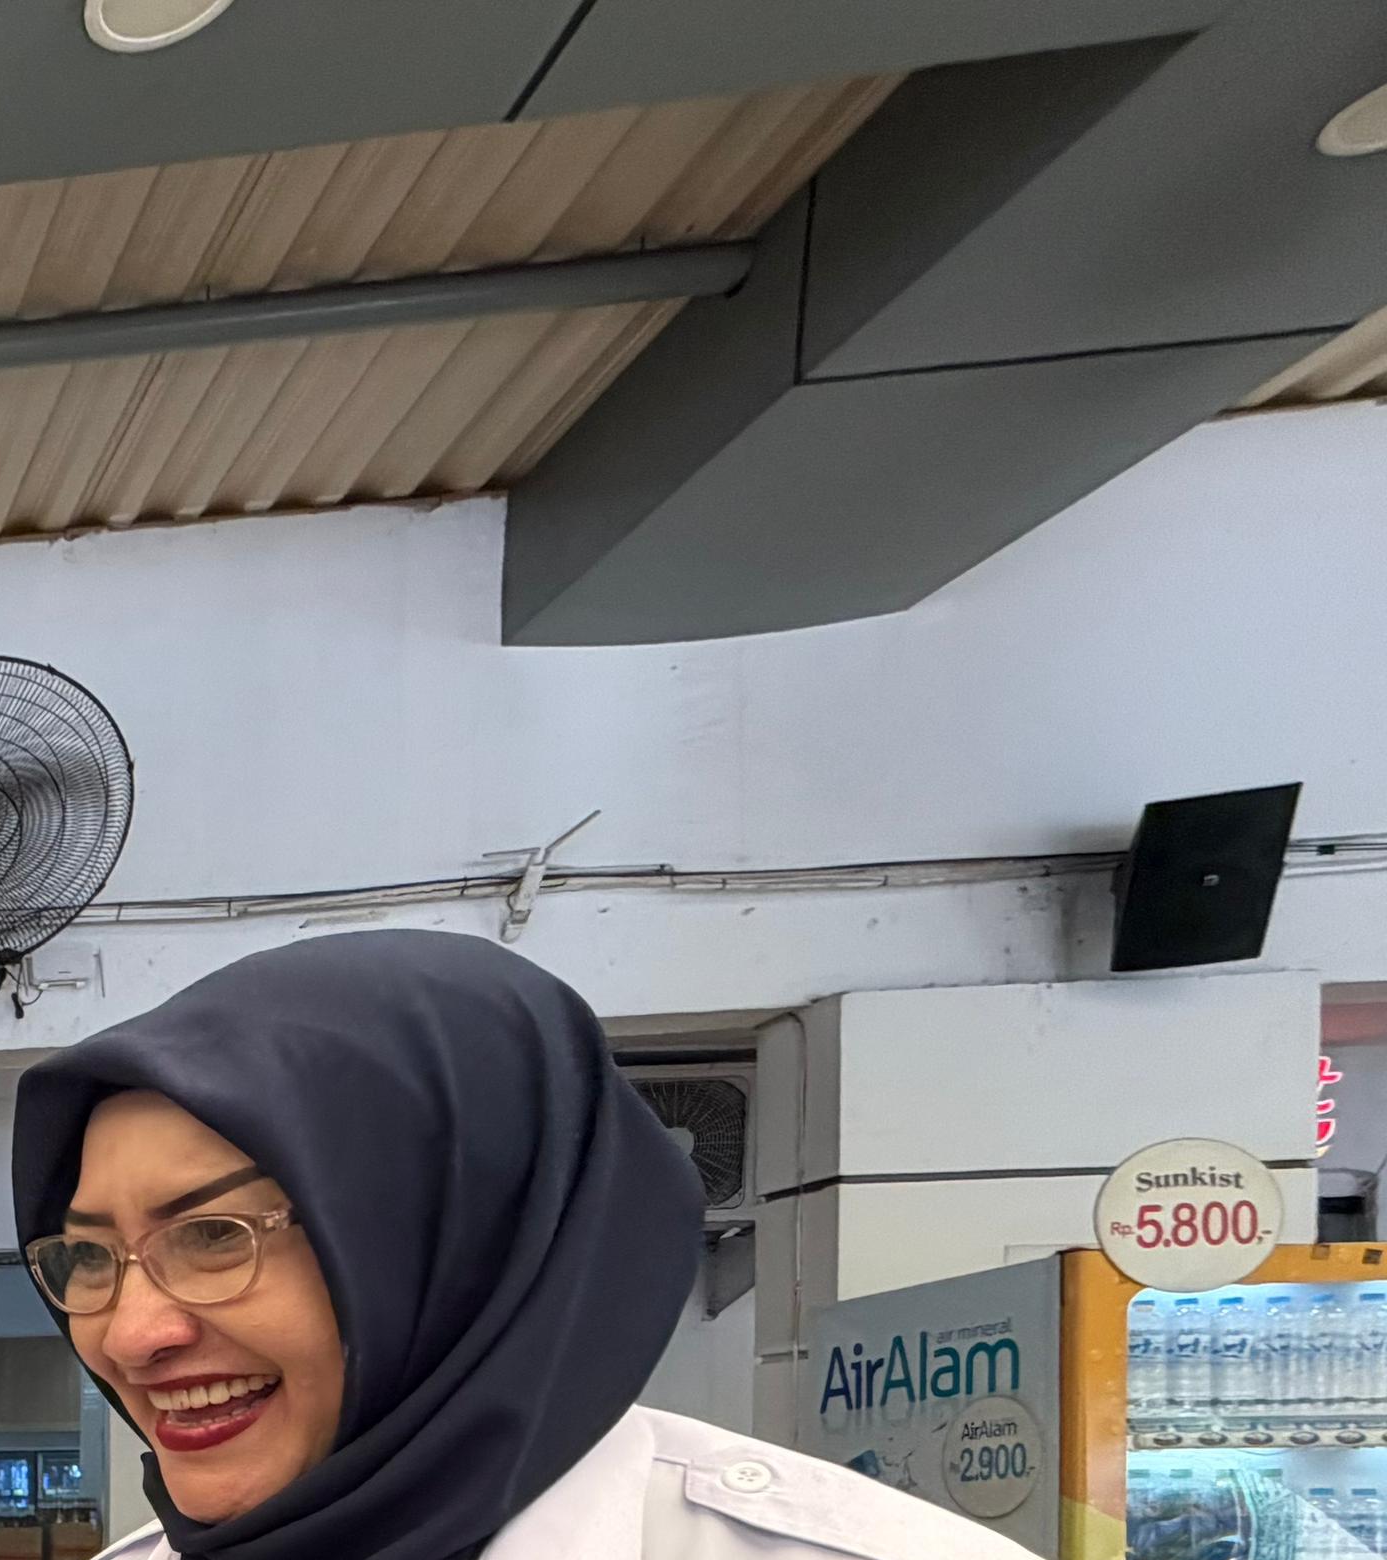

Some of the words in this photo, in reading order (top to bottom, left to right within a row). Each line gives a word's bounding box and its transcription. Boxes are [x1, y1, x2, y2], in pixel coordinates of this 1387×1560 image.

[1135, 1165, 1245, 1193] Sunkist
[819, 1331, 1020, 1414] AirAlam
[960, 1420, 1018, 1440] AirAlam
